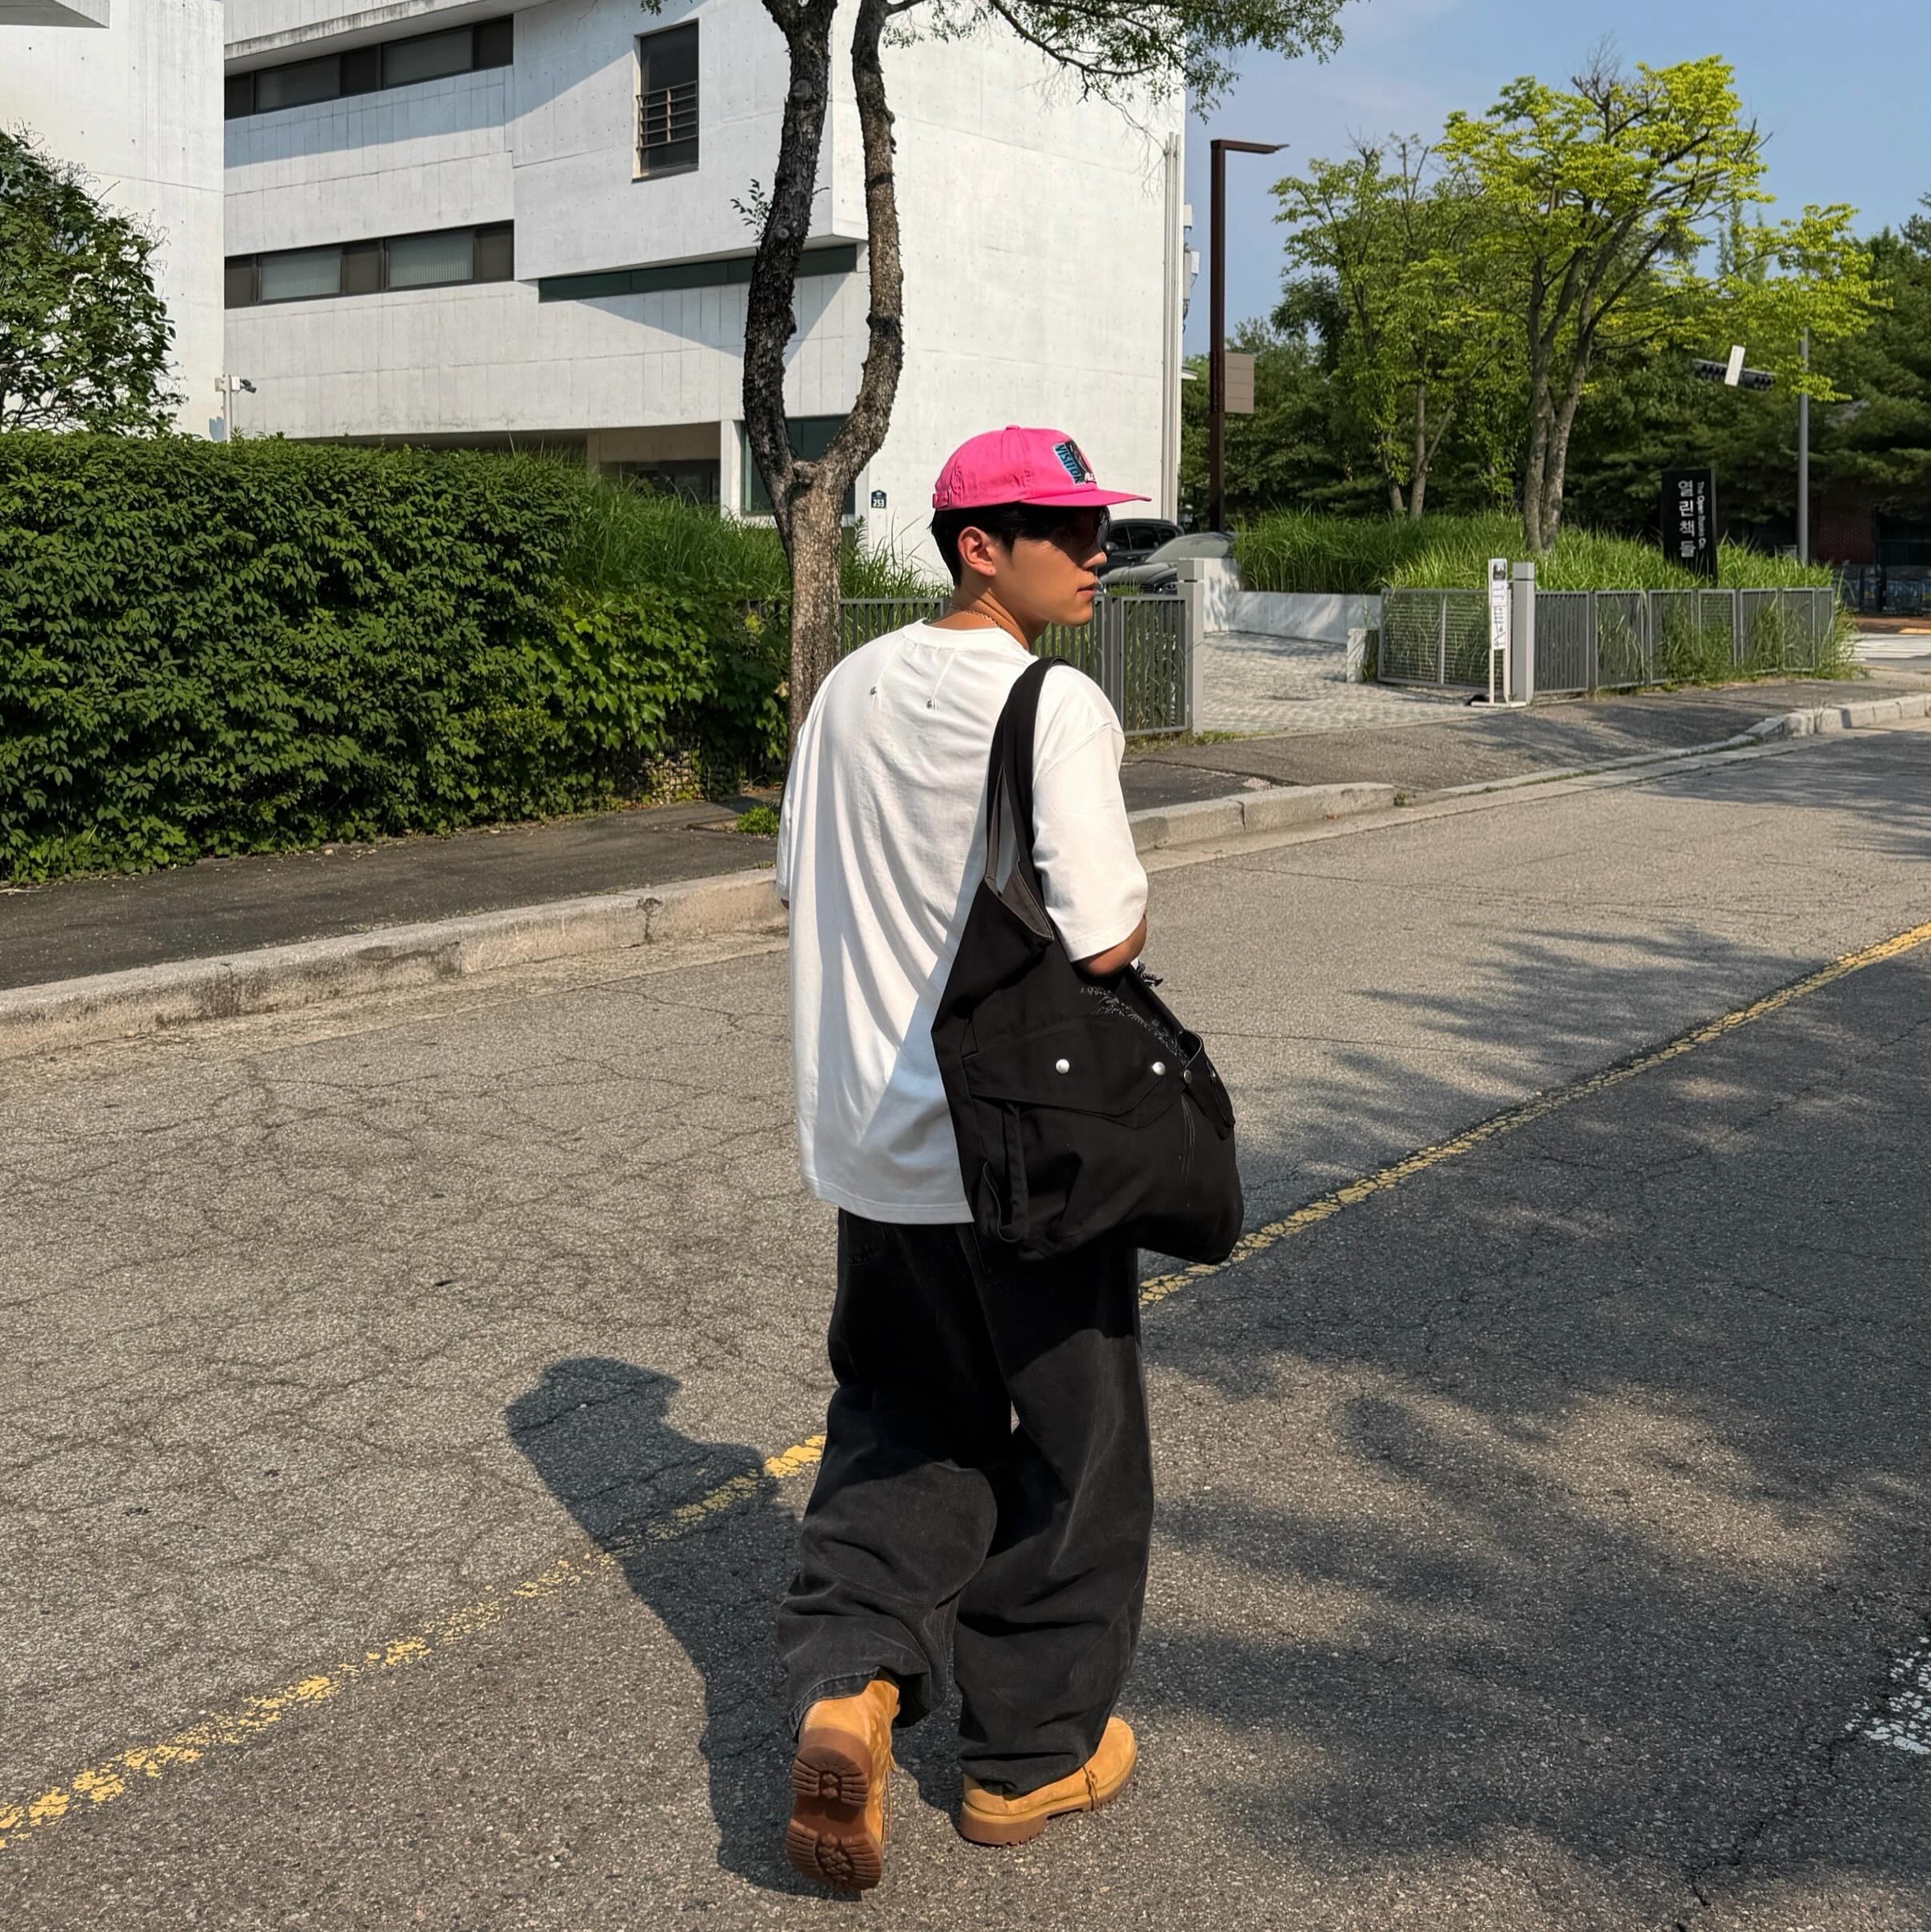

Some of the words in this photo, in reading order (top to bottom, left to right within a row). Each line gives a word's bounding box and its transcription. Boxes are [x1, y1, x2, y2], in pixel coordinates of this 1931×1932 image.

[1055, 444, 1082, 484] VISITOR
[873, 499, 885, 507] 253
[1696, 495, 1705, 514] Open
[1678, 480, 1695, 557] 열린책들
